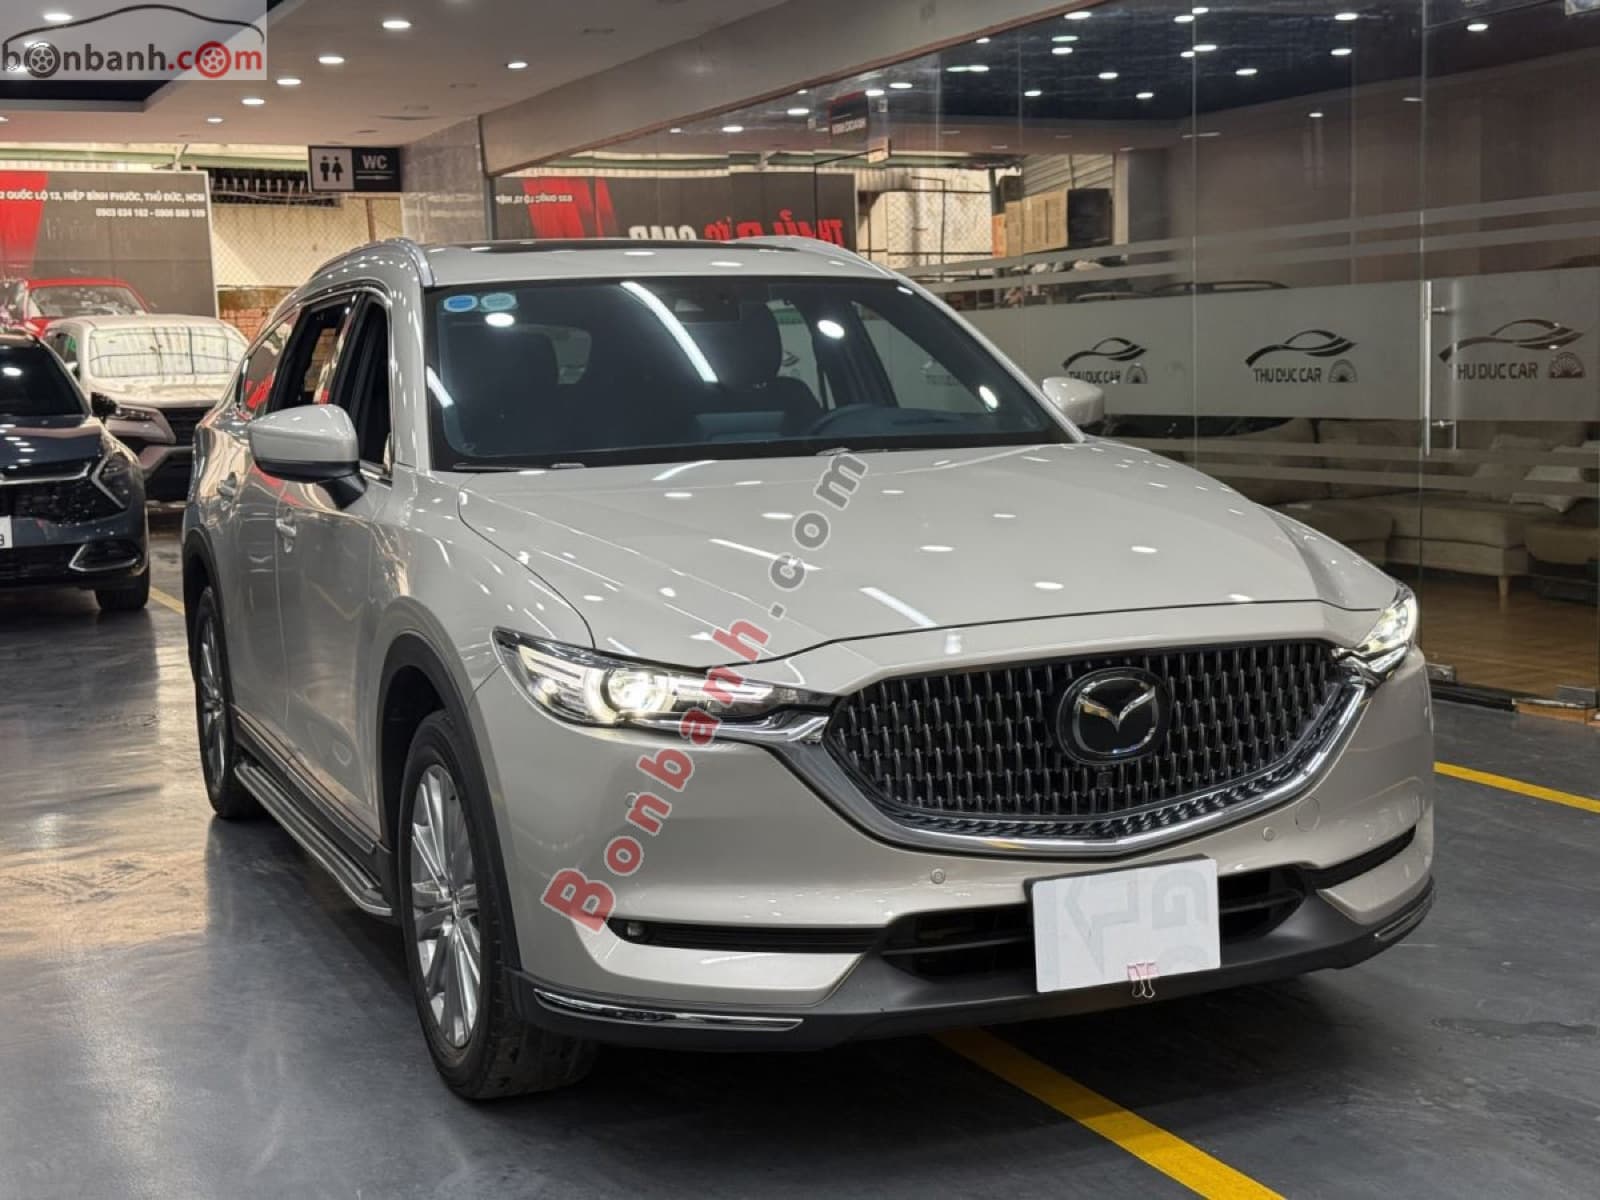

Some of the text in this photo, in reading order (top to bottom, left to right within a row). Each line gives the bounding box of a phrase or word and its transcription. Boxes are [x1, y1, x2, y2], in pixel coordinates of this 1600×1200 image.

[361, 154, 388, 169] WC
[1299, 367, 1322, 383] CAR
[1508, 361, 1538, 379] CAR
